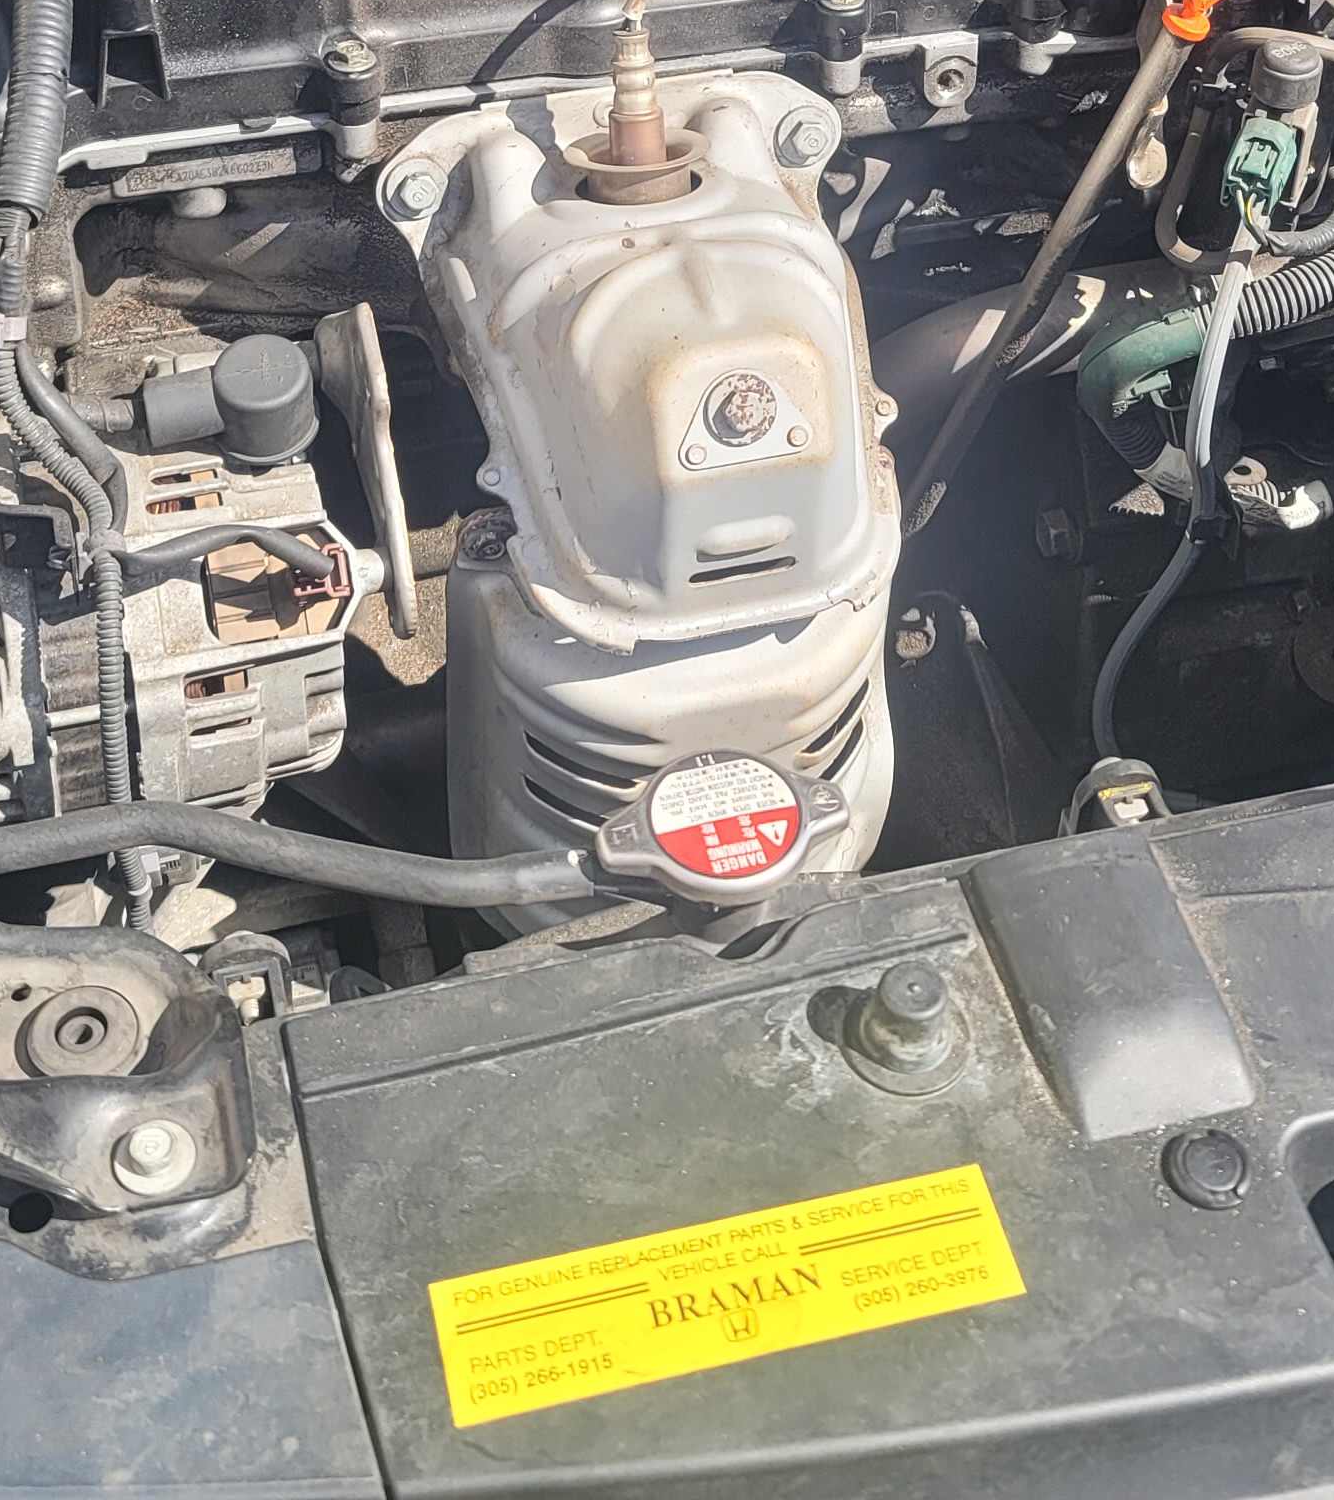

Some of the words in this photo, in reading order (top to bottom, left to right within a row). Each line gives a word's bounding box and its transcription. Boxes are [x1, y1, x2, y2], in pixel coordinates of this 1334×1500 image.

[694, 753, 715, 767] 1.1
[708, 808, 727, 819] WHEN
[732, 803, 751, 814] OPEN
[755, 798, 777, 809] NEVER
[707, 838, 762, 860] WARNUNG
[711, 851, 767, 875] DANGER
[453, 1285, 495, 1307] FOR
[498, 1264, 585, 1297] GENUINE
[588, 1235, 722, 1277] REPLACEMENT
[728, 1220, 788, 1248] PARTS
[791, 1216, 804, 1231] &
[808, 1198, 886, 1227] SERVICE
[888, 1187, 927, 1207] FOR
[928, 1179, 971, 1198] THIS
[657, 1252, 738, 1283] VEHICLE
[741, 1242, 789, 1264] CALL
[841, 1254, 928, 1287] SERVICE
[646, 1263, 823, 1330] BRAMAN
[853, 1286, 902, 1312] (305)
[907, 1265, 990, 1297] 260-3976
[469, 1343, 537, 1375] PARTS
[542, 1329, 603, 1357] DEPT.
[469, 1377, 518, 1405] (305)
[525, 1353, 614, 1389] 266-1915
